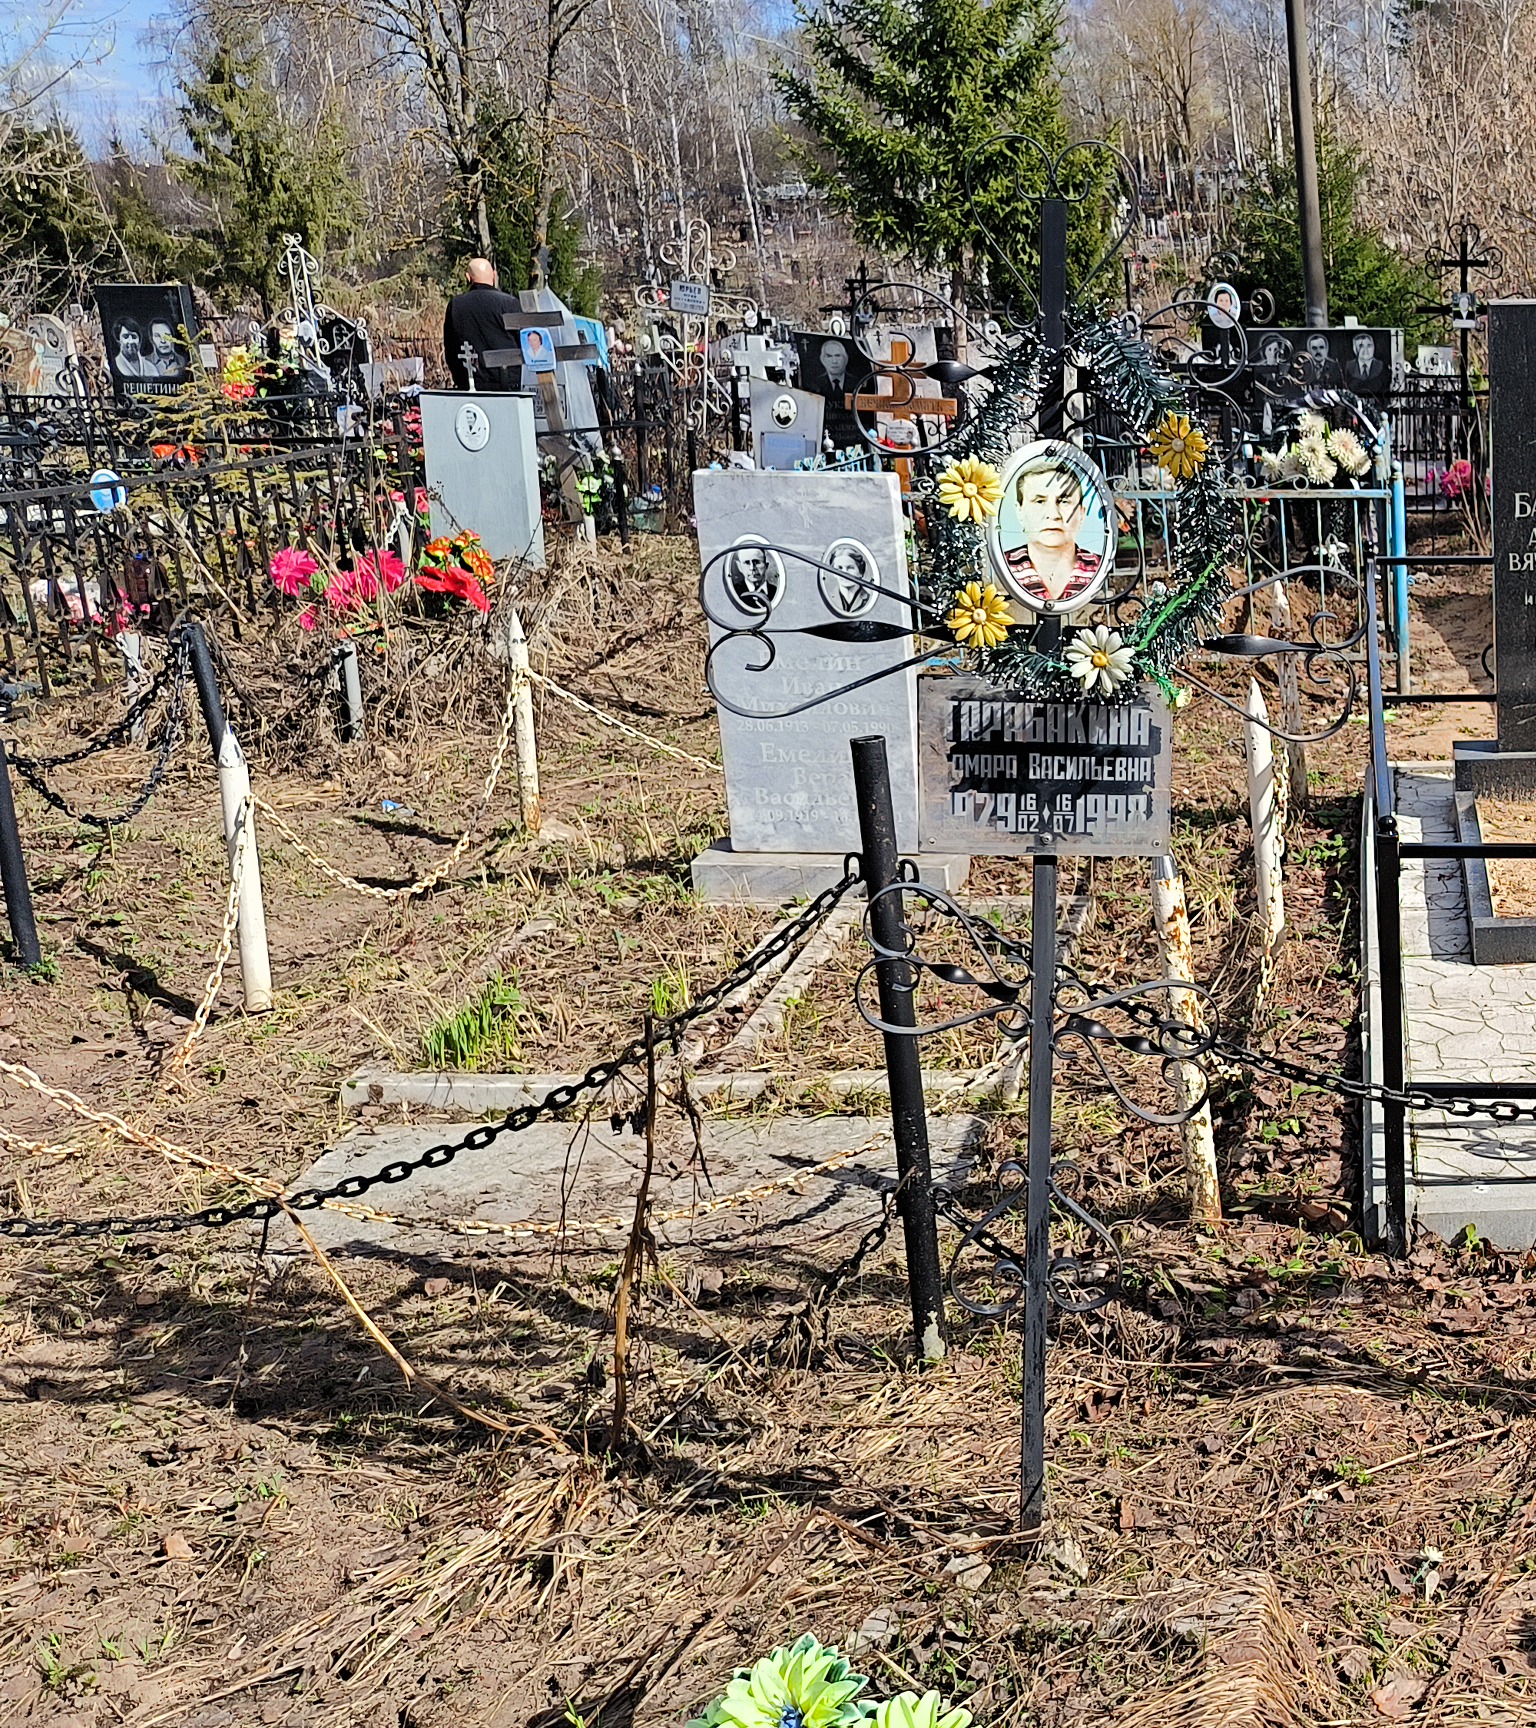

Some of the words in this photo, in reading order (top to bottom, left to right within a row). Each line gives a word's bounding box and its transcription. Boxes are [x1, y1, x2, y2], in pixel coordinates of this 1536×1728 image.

[945, 700, 1151, 746] ТАРАБАКИНА
[947, 753, 1017, 779] АМАРА
[1029, 752, 1151, 782] ВАСИЛЬЕВНА
